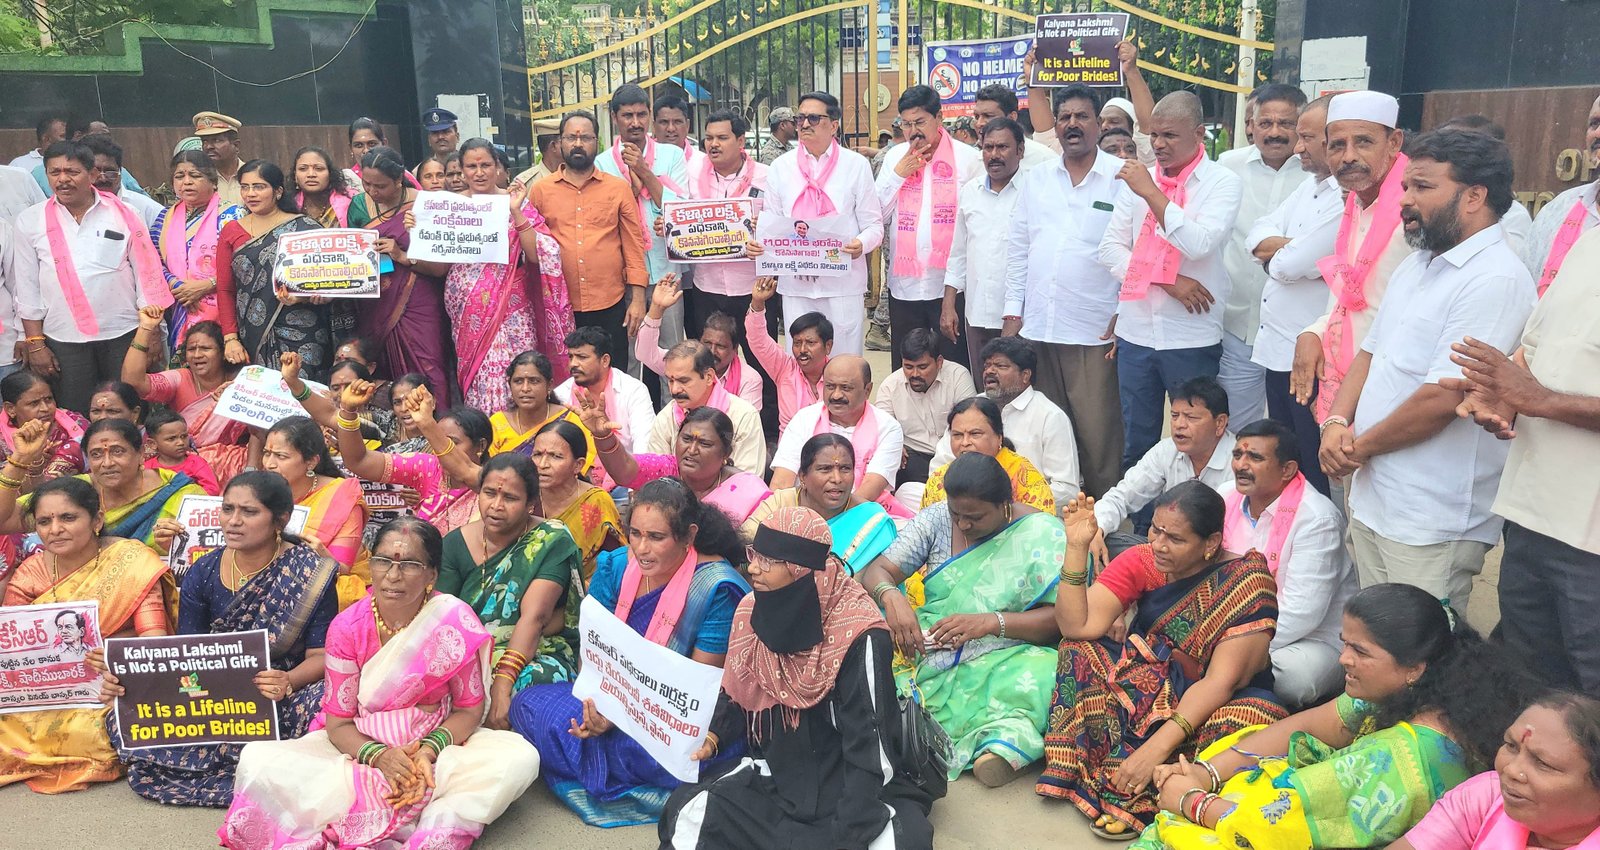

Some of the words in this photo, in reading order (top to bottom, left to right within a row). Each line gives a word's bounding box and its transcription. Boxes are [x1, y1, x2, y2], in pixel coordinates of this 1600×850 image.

[1044, 20, 1076, 29] Kalyana
[1077, 18, 1114, 27] Lakshmi
[1045, 29, 1059, 37] Not
[1067, 28, 1100, 37] Political
[1102, 27, 1120, 36] Gift
[962, 62, 980, 76] NO
[982, 58, 1024, 75] HELME
[1044, 58, 1052, 68] It
[1054, 58, 1062, 68] is
[1072, 57, 1110, 68] Lifeline
[1038, 71, 1054, 81] for
[1056, 71, 1080, 81] Poor
[1082, 71, 1118, 81] Brides!
[962, 80, 978, 92] NO
[124, 646, 180, 661] Kalyana
[182, 640, 243, 657] Lakshmi
[114, 662, 126, 674] is
[129, 661, 155, 674] Not
[158, 663, 167, 672] a
[170, 657, 227, 672] Political
[230, 655, 258, 669] Gift
[136, 704, 152, 718] It
[155, 702, 171, 717] is
[175, 705, 187, 717] a
[190, 698, 256, 716] Lifeline
[130, 724, 159, 740] for
[163, 722, 206, 738] Poor
[209, 719, 270, 736] Brides!
